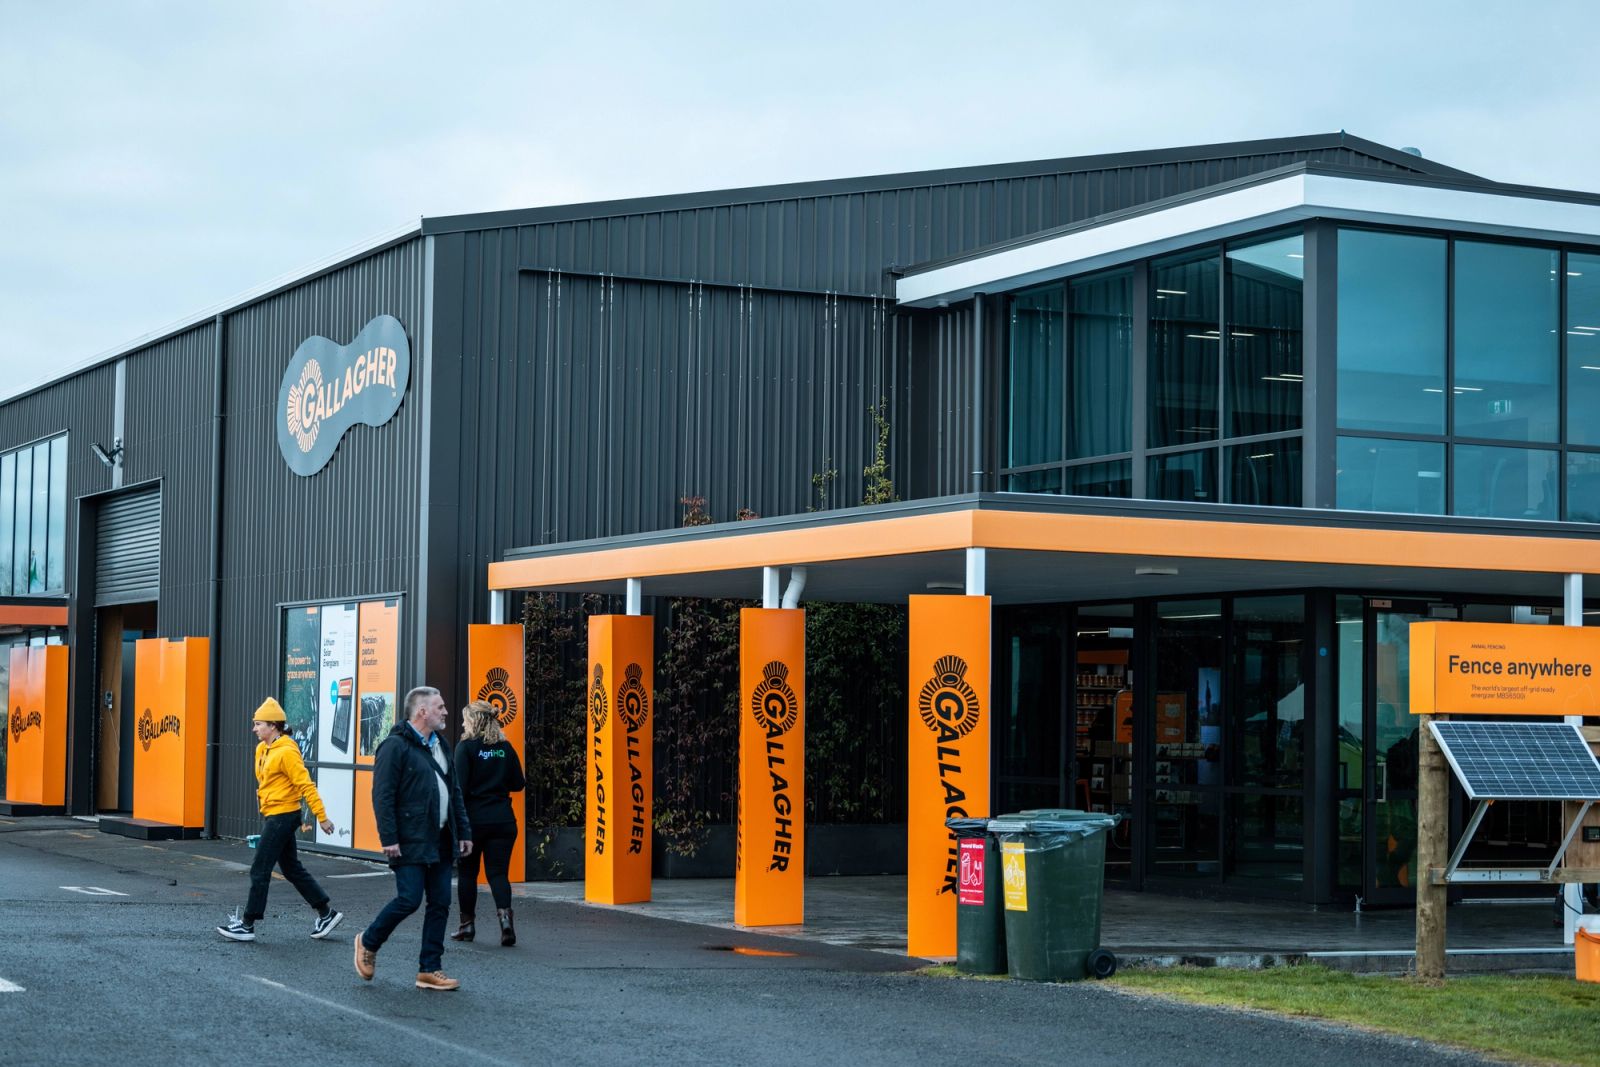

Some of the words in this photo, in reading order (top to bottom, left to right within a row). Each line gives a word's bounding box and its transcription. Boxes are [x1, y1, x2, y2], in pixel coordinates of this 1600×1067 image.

[302, 347, 397, 429] GALLAGHER
[1448, 655, 1503, 674] Fence
[1507, 657, 1592, 680] anywhere
[1501, 685, 1520, 693] largest
[15, 711, 42, 733] GALLAGHER
[144, 715, 181, 741] GALLAGHER
[478, 749, 506, 760] AgriHQ
[593, 691, 606, 856] GALLAGHER
[625, 691, 645, 855] GALLAGHER
[764, 692, 792, 873] GALLAGHER
